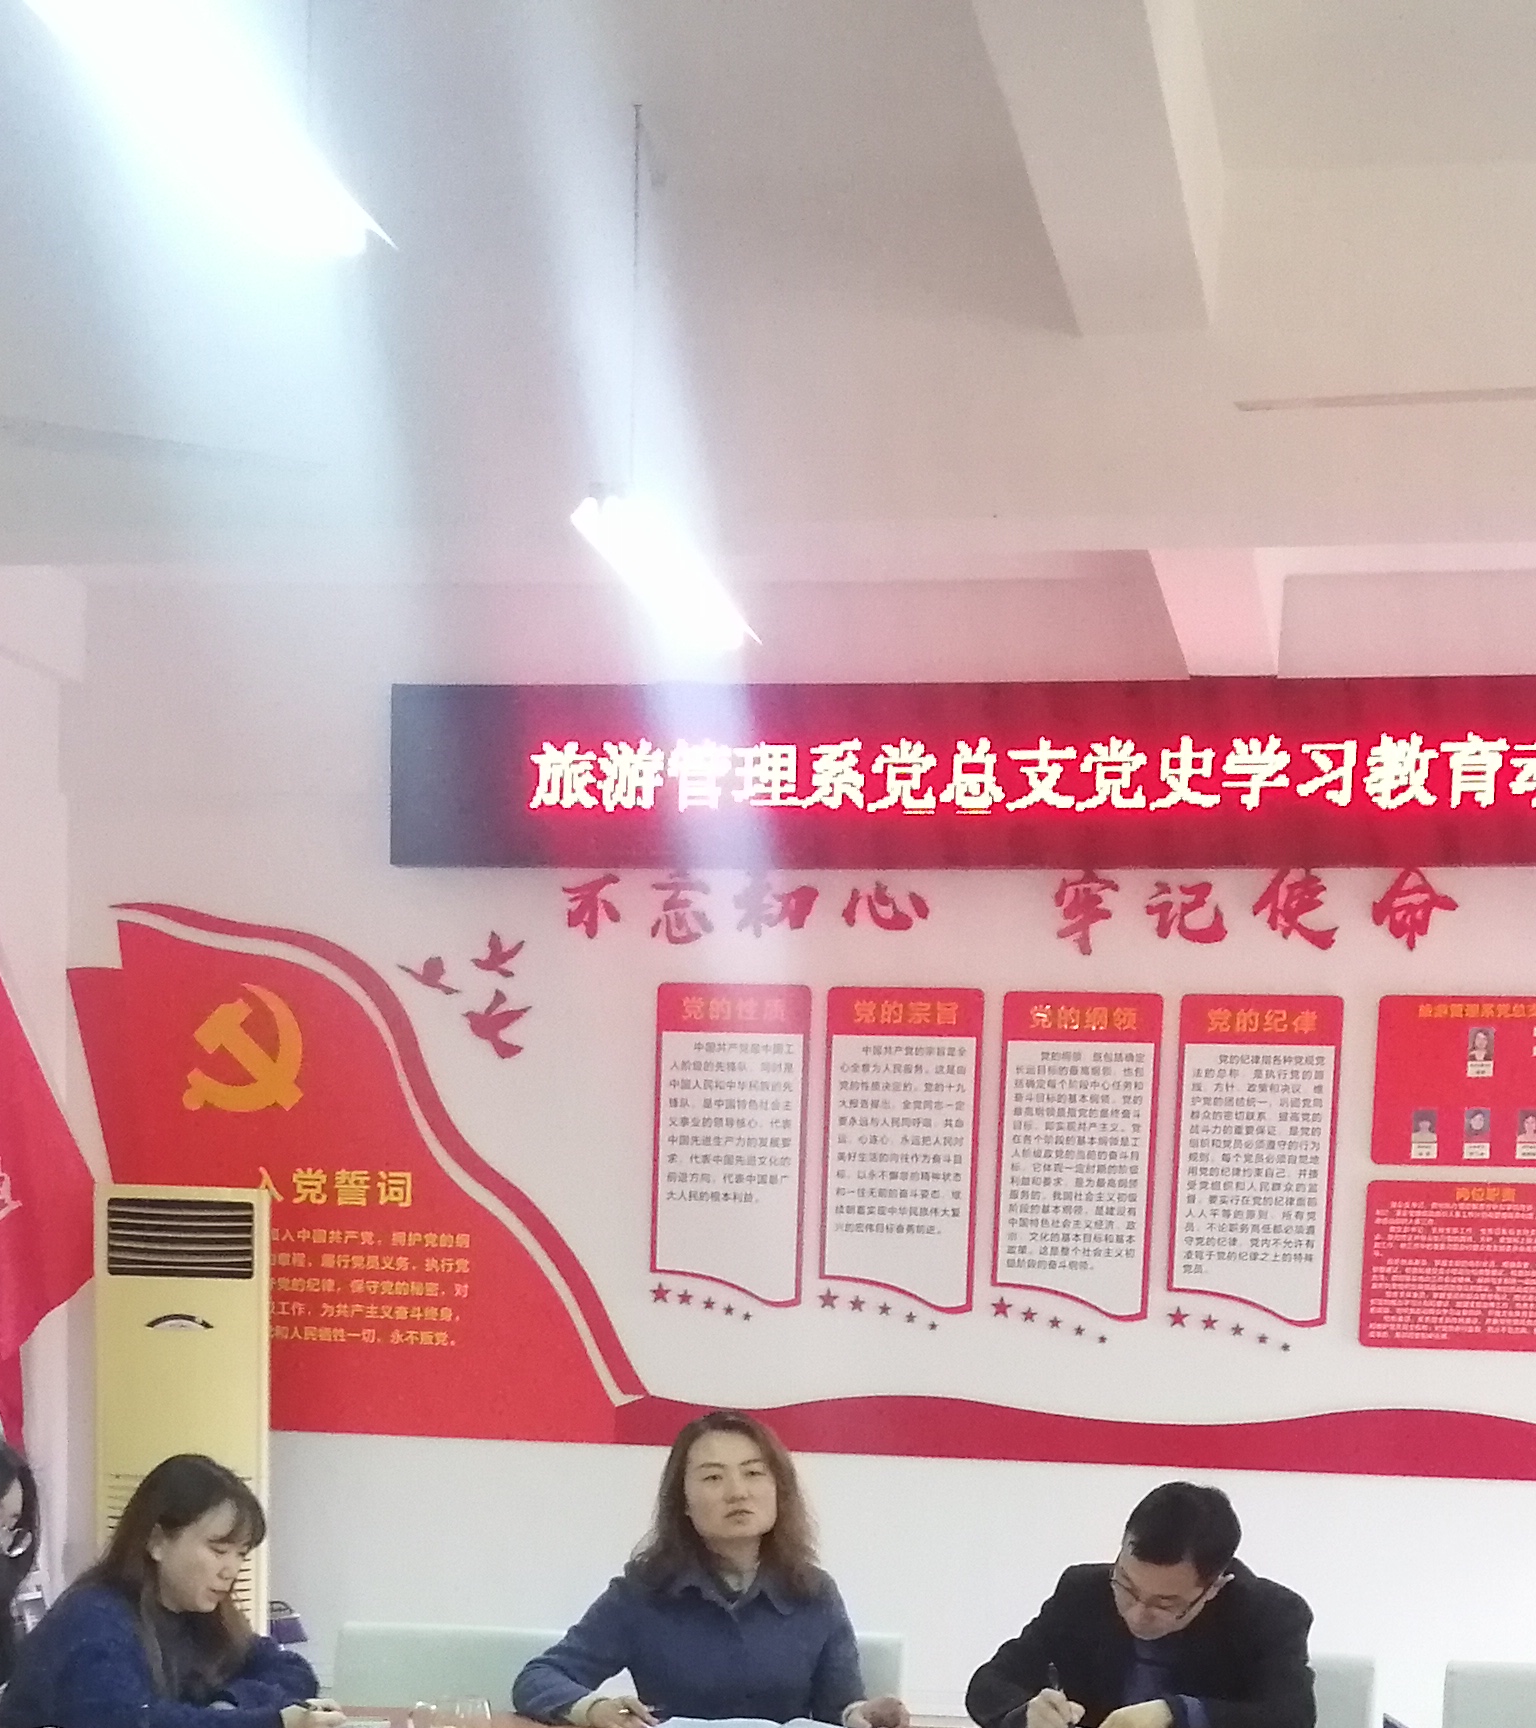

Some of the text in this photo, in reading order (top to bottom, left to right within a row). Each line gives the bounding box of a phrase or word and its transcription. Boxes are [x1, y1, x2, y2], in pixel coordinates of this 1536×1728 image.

[563, 867, 1459, 955] 不忘初心 牢记使命
[854, 1000, 959, 1025] 党的宗旨
[1029, 1004, 1138, 1031] 党的纲领
[1207, 1007, 1318, 1034] 党的纪律
[259, 1167, 414, 1208] 入党誓词
